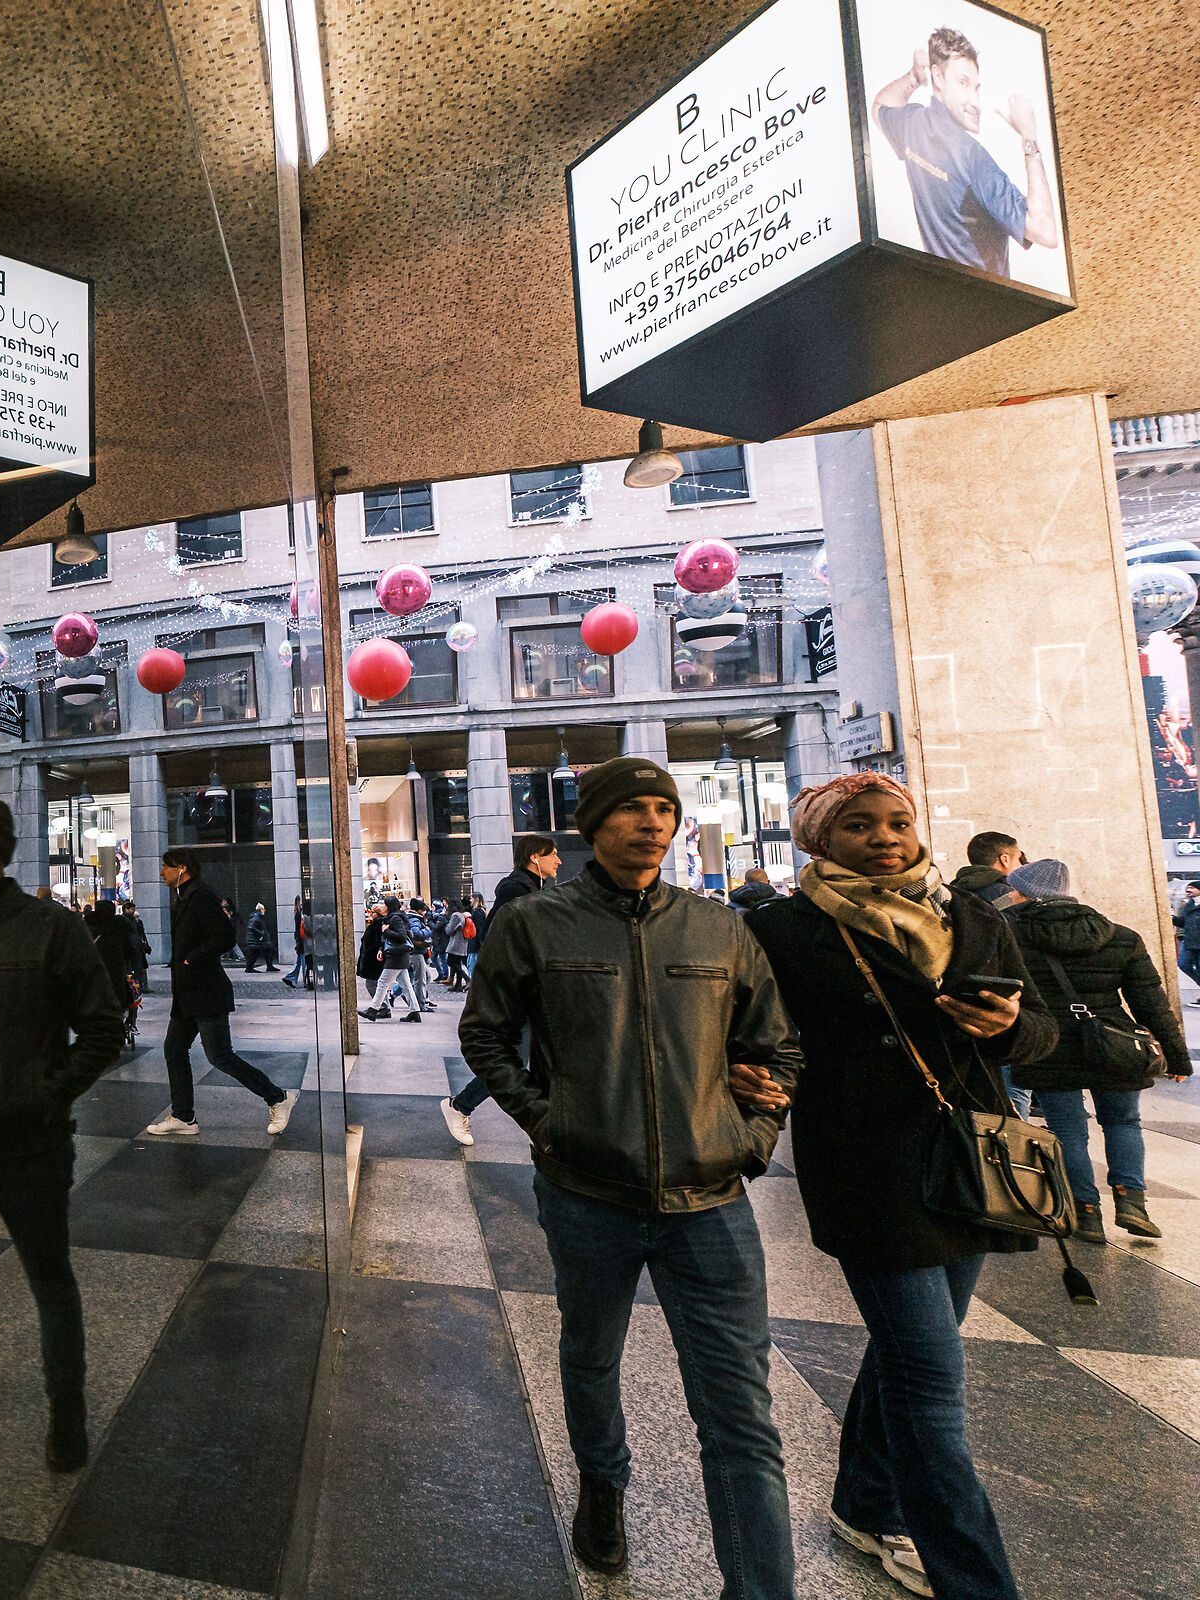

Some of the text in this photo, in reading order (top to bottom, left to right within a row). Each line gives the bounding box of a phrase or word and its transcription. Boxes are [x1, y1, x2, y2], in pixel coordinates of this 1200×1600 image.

[589, 86, 827, 263] Dr. Pierfrancesco Bove
[611, 67, 788, 215] YOU CLINIC
[676, 92, 701, 135] B
[603, 130, 805, 273] Medicina e Chirurgia Estetica
[608, 178, 804, 315] INFO E PRENOTAZIONI
[624, 212, 792, 326] +39 3756046764
[646, 182, 754, 261] e del Benessere
[599, 216, 833, 364] www.pierfrancescobove.it
